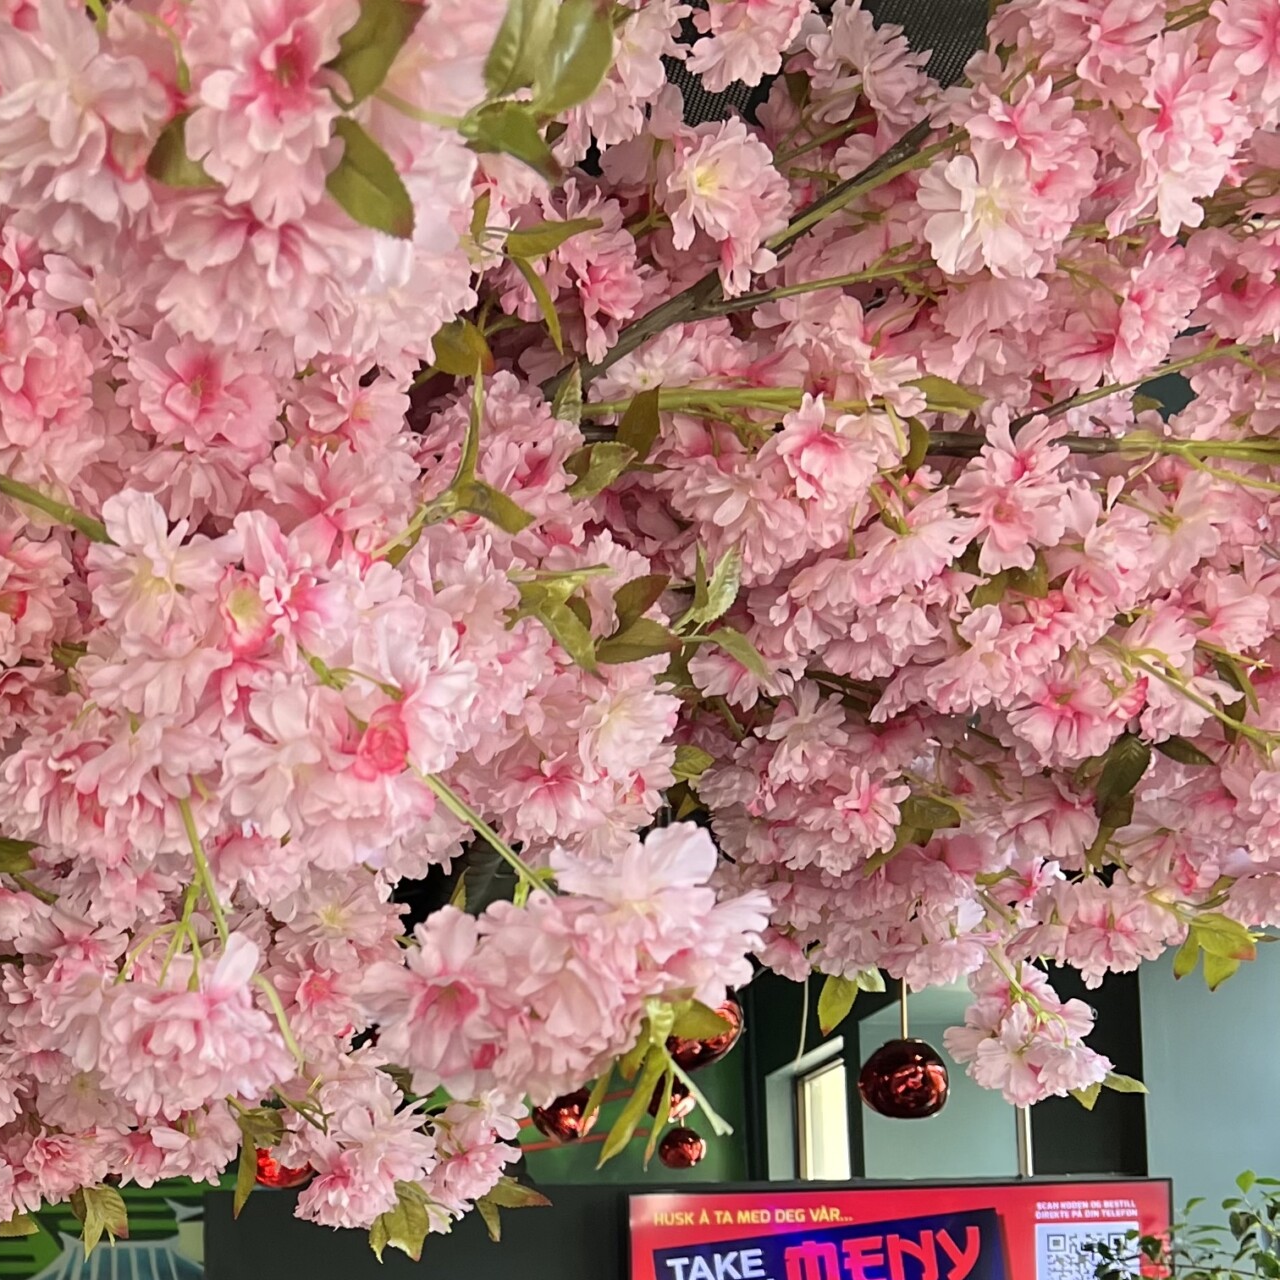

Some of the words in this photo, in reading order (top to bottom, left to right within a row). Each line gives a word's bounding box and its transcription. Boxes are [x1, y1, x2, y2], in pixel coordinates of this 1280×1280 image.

[654, 1212, 694, 1226] HUSK
[699, 1208, 710, 1225] Å
[714, 1210, 733, 1225] TA
[737, 1209, 771, 1224] MED
[775, 1208, 805, 1224] DEG
